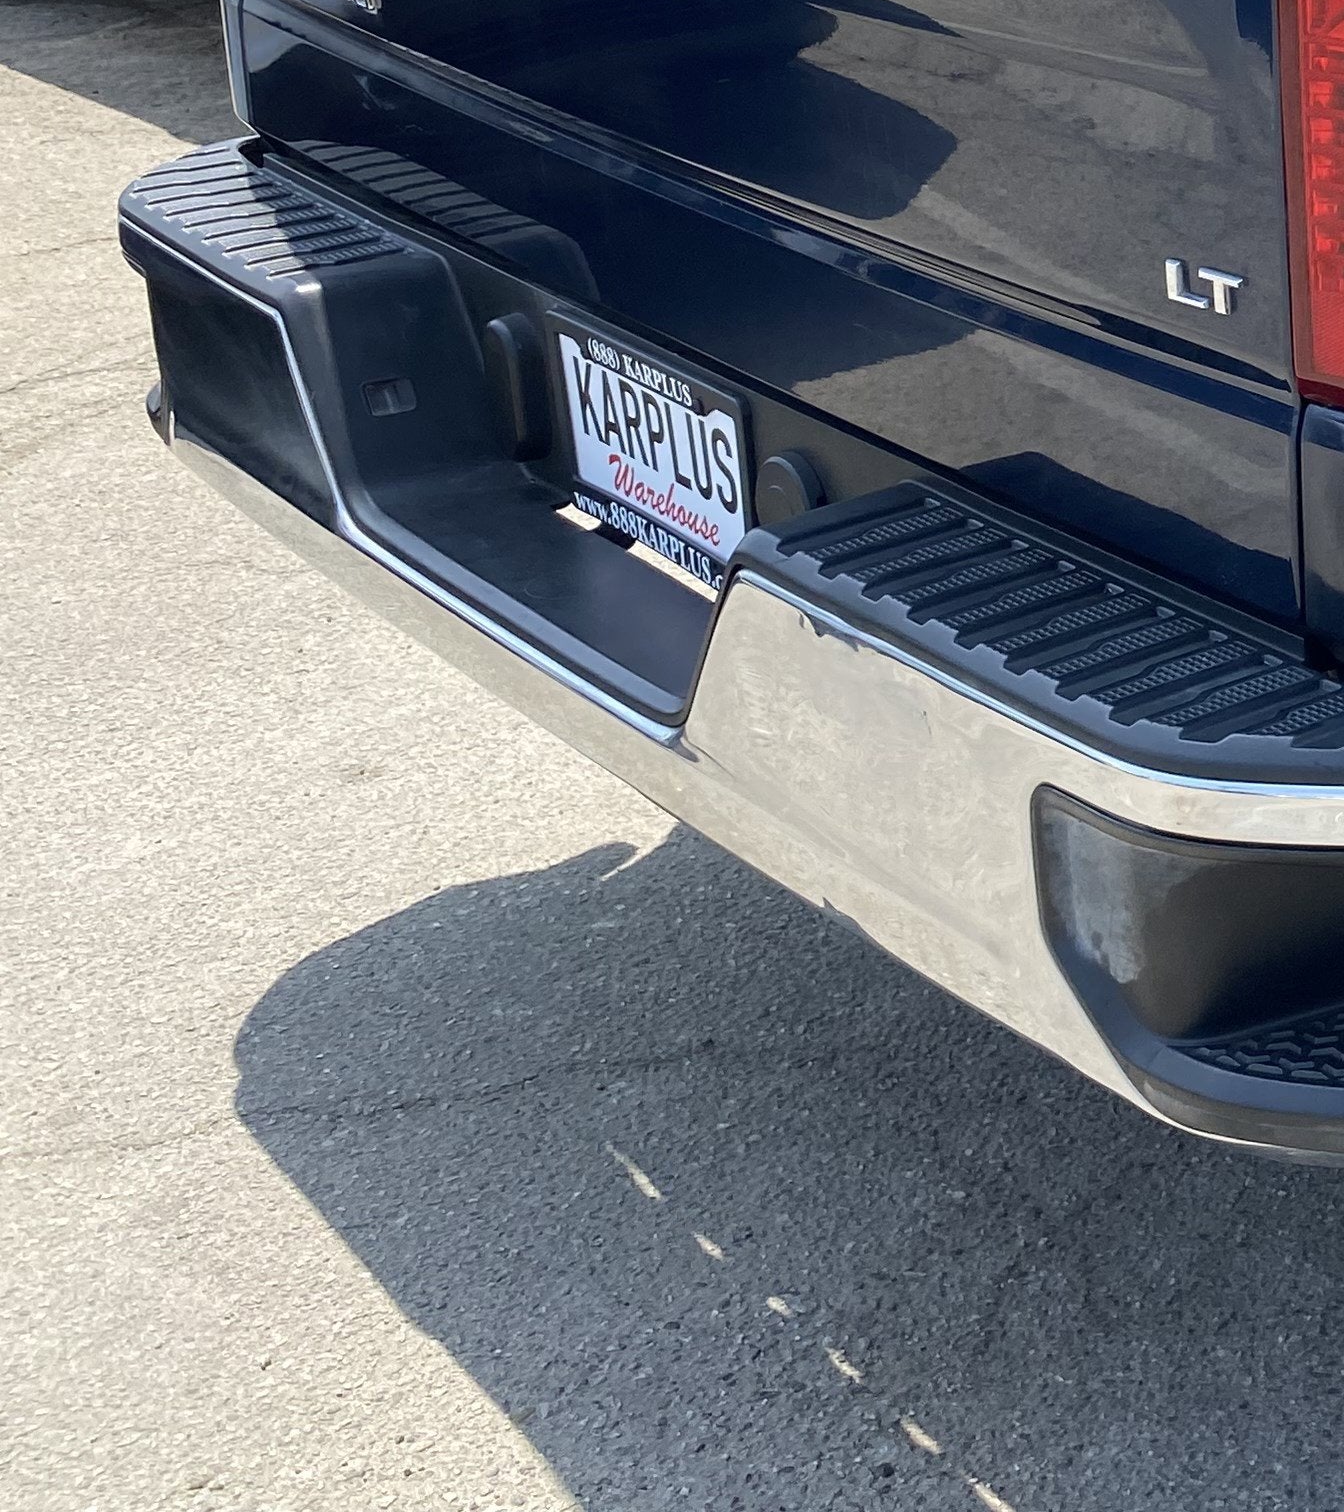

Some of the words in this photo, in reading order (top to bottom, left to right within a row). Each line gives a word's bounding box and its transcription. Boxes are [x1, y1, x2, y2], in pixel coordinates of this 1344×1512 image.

[1165, 257, 1244, 315] LT
[587, 336, 619, 372] (888)
[621, 354, 693, 407] KARPLUS
[572, 355, 739, 515] KARPLUS
[573, 490, 724, 590] www.888KARPLUS.c
[608, 452, 721, 547] Warehouse
